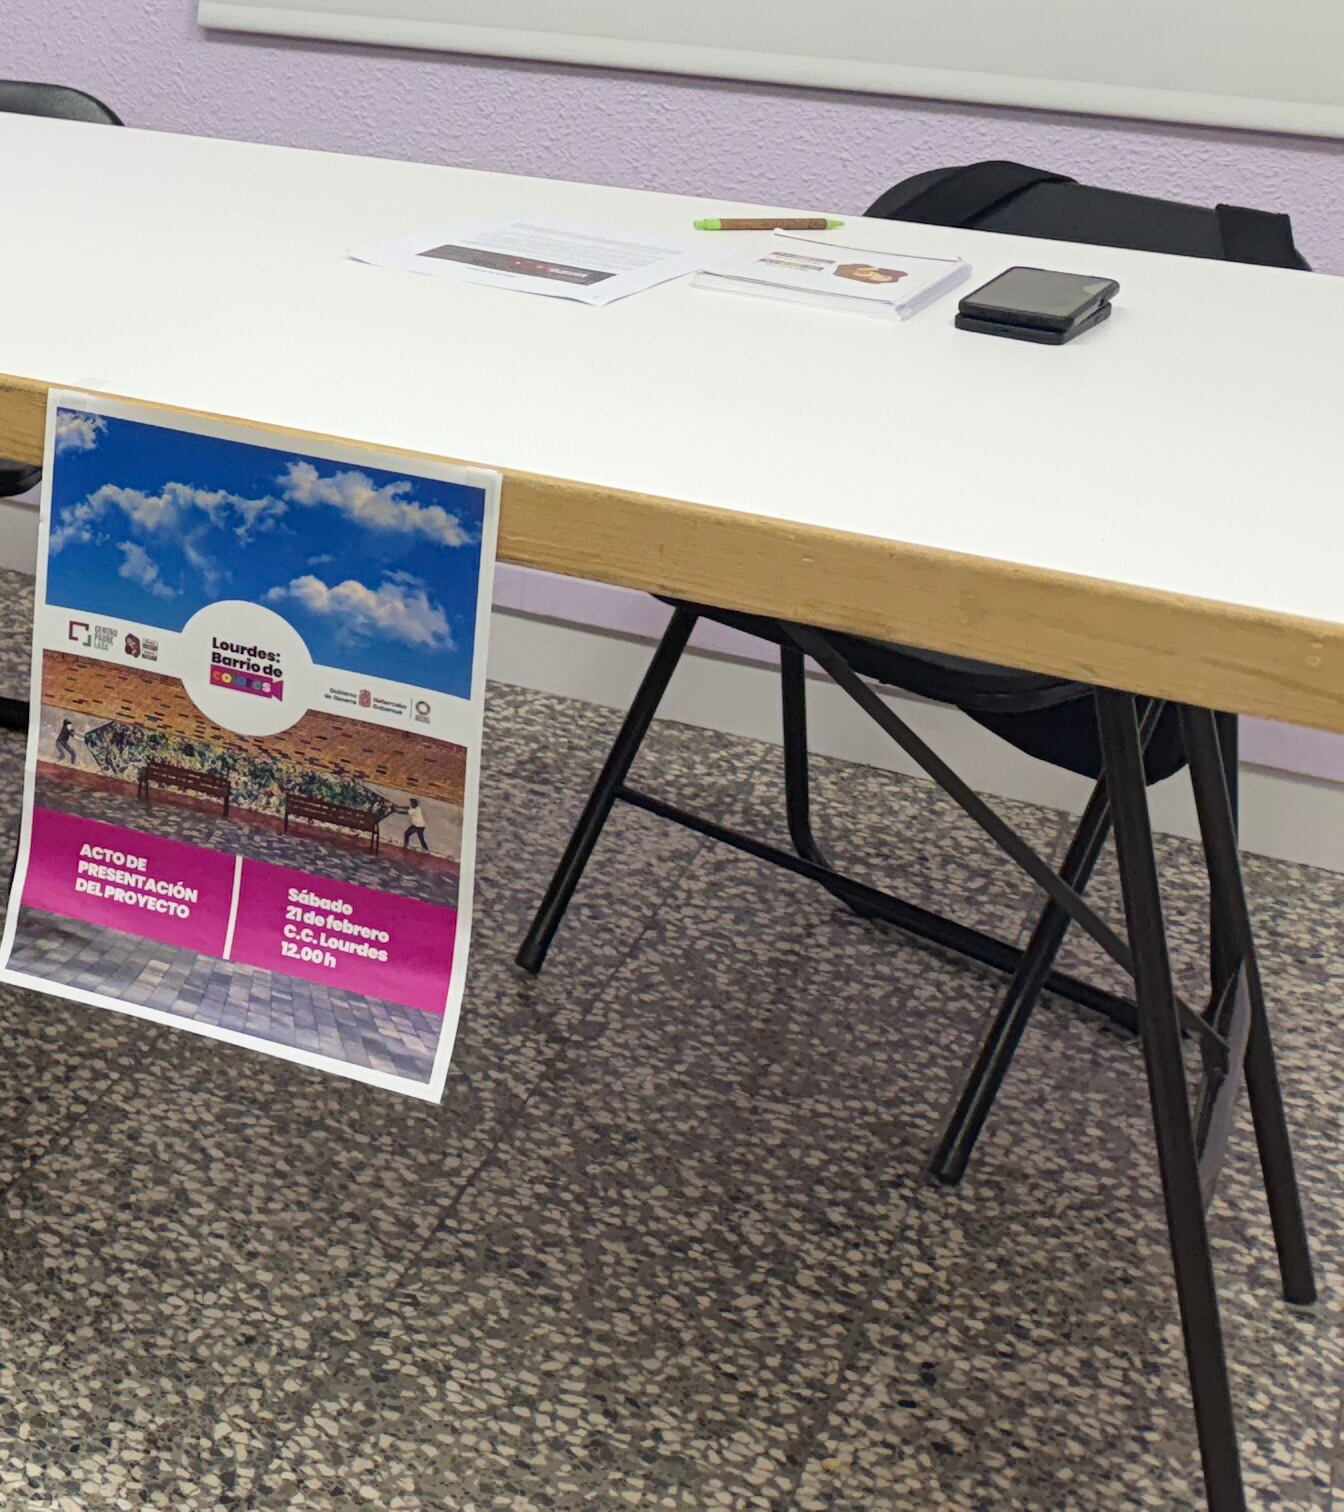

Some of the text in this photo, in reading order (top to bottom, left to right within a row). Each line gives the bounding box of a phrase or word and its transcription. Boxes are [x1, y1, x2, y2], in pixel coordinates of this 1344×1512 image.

[212, 637, 281, 663] Lourdes:
[212, 651, 282, 678] Barrio de
[212, 670, 272, 693] colores
[79, 843, 148, 872] ACTO DE
[77, 860, 198, 903] PRESENTACIÓN
[75, 877, 190, 919] DEL PROYECTO
[288, 888, 353, 915] Sábado
[285, 905, 390, 943] 21 de febrero
[281, 941, 337, 968] 12.00 h
[283, 924, 389, 962] C.C. Lourdes
